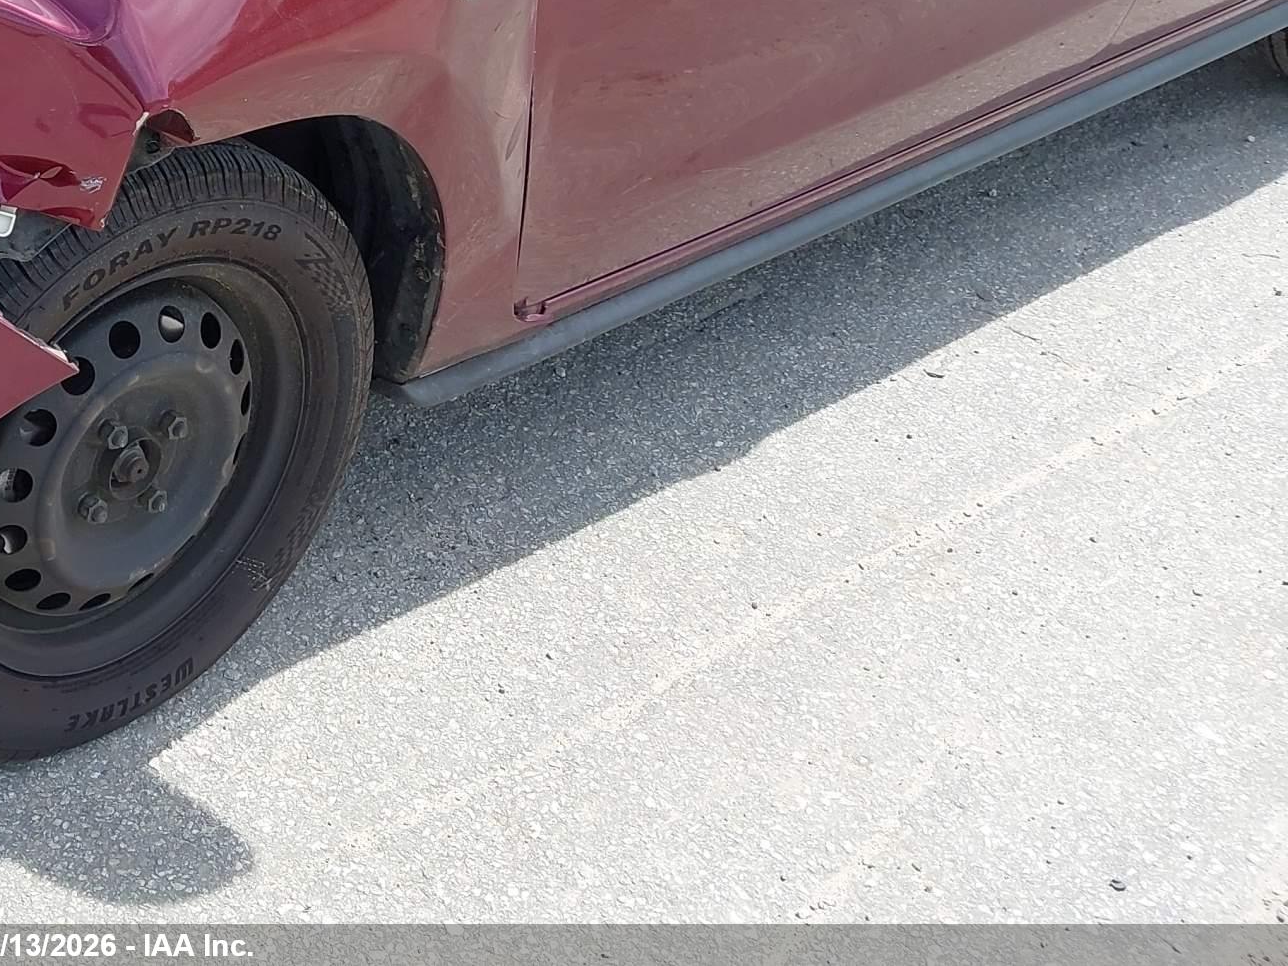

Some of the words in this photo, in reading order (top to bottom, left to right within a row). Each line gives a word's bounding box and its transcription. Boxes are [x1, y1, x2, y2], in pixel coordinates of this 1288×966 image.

[63, 226, 178, 312] FORAY
[188, 217, 283, 241] RP218
[63, 657, 194, 732] WESTLAKE
